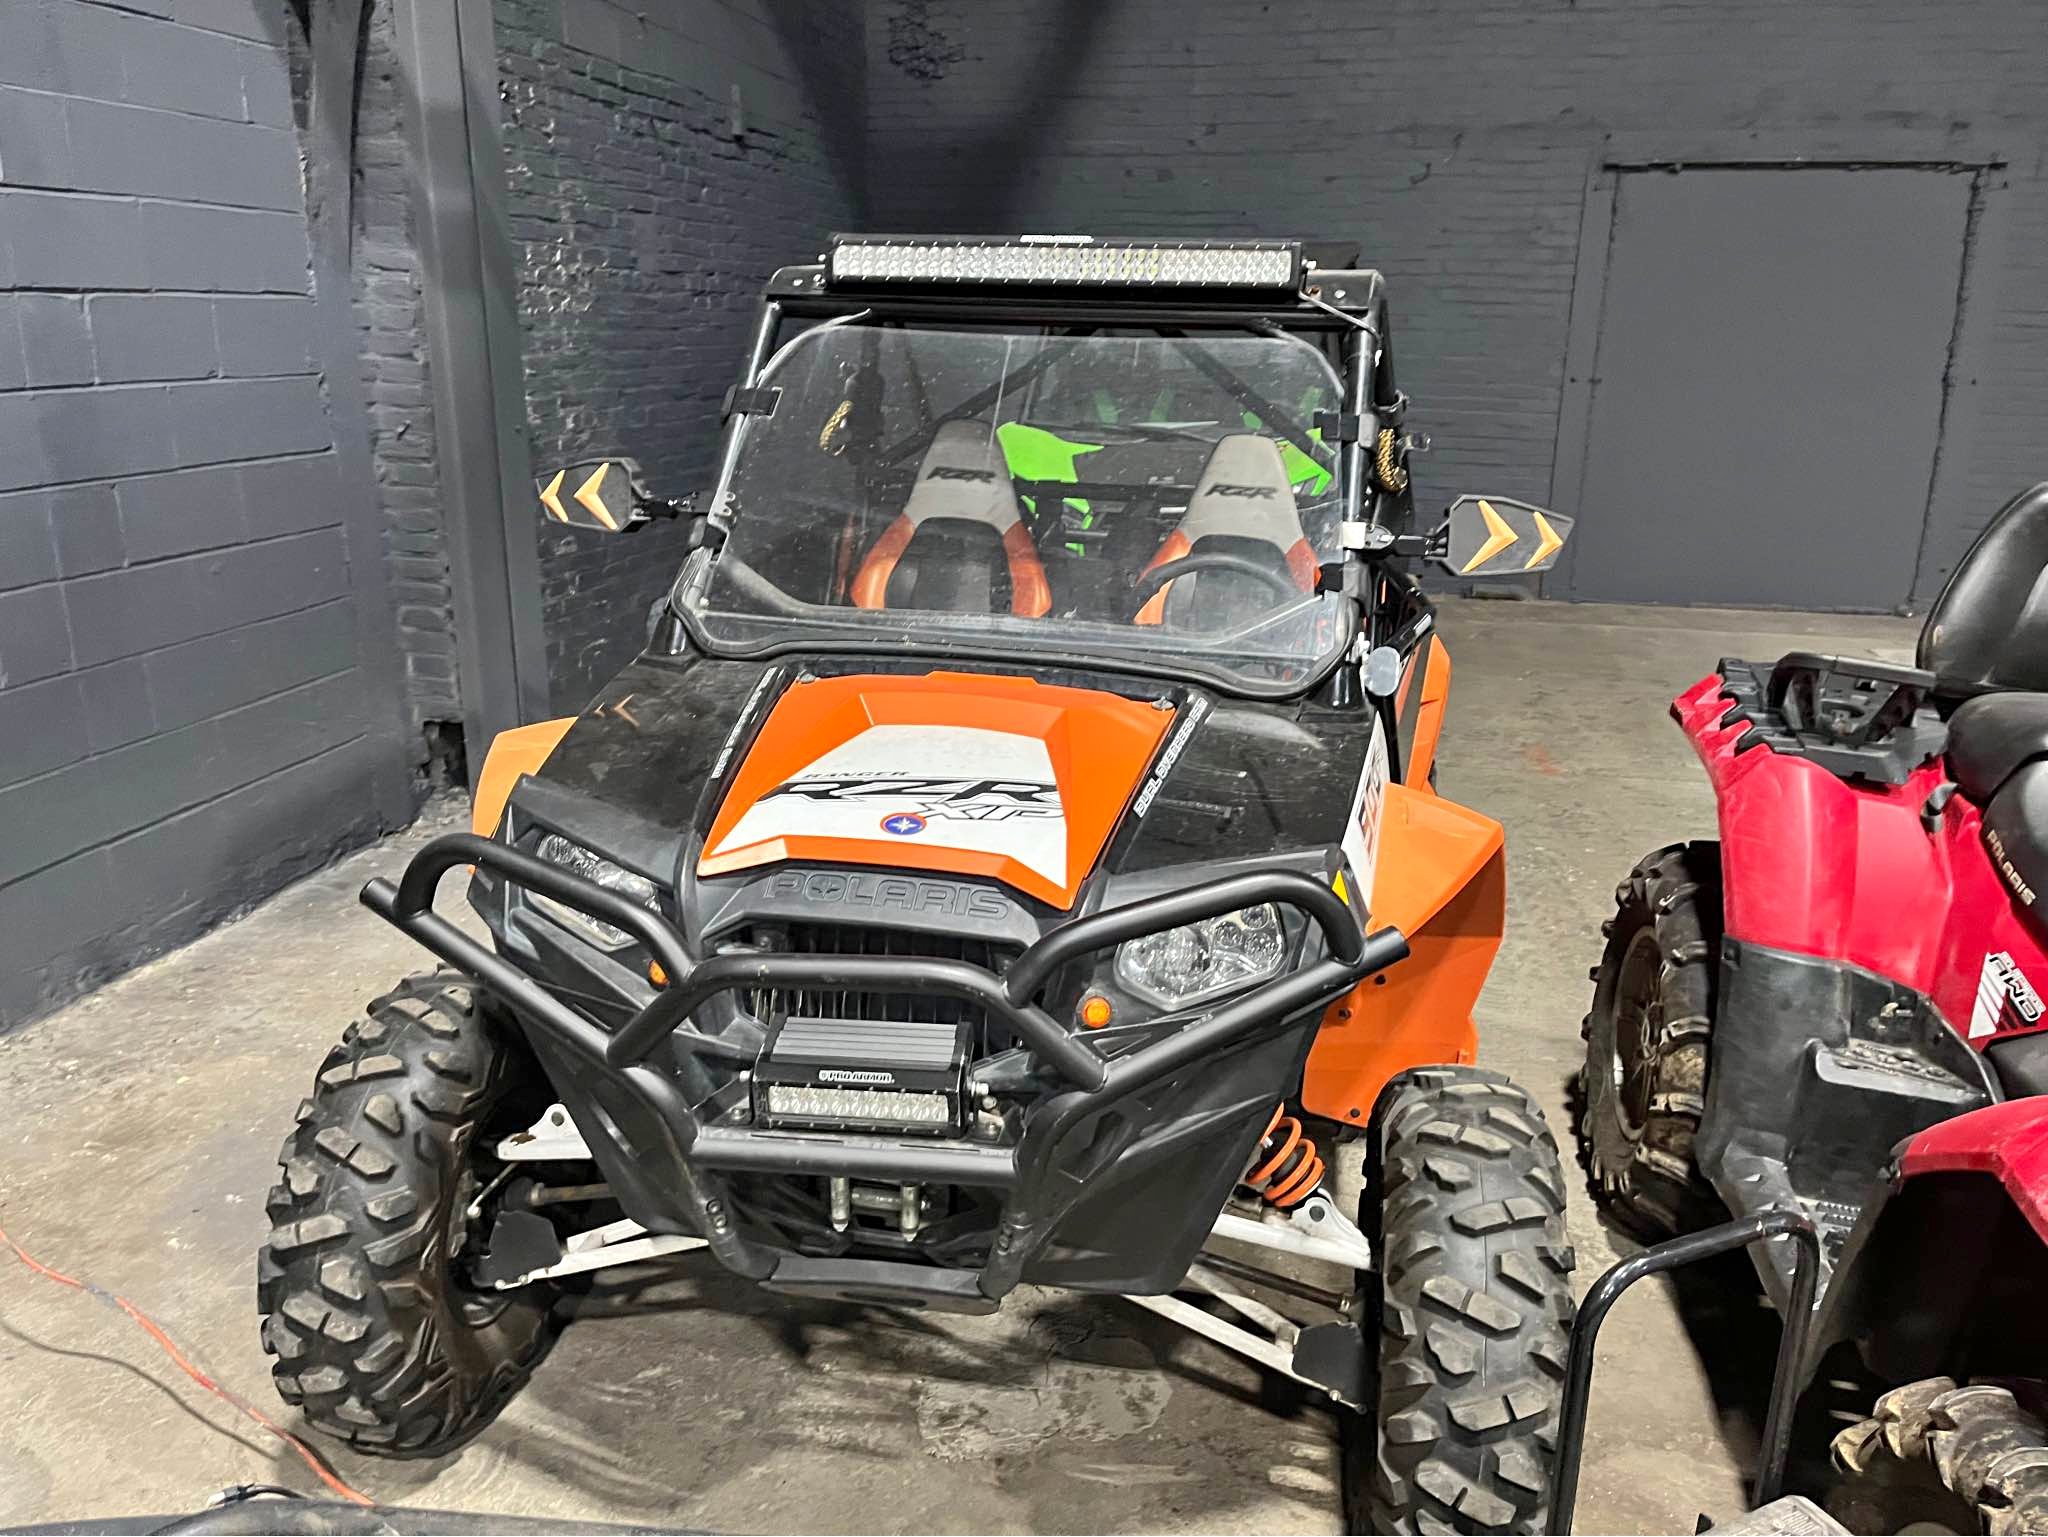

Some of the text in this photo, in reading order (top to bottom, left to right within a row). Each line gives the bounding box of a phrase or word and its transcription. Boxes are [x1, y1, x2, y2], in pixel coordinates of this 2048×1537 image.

[926, 466, 997, 484] RZR
[1203, 484, 1279, 500] RZR
[802, 771, 910, 779] RANGER
[754, 779, 1062, 804] RZR
[1987, 829, 2037, 906] POLARIS
[763, 871, 1009, 920] POLARIS
